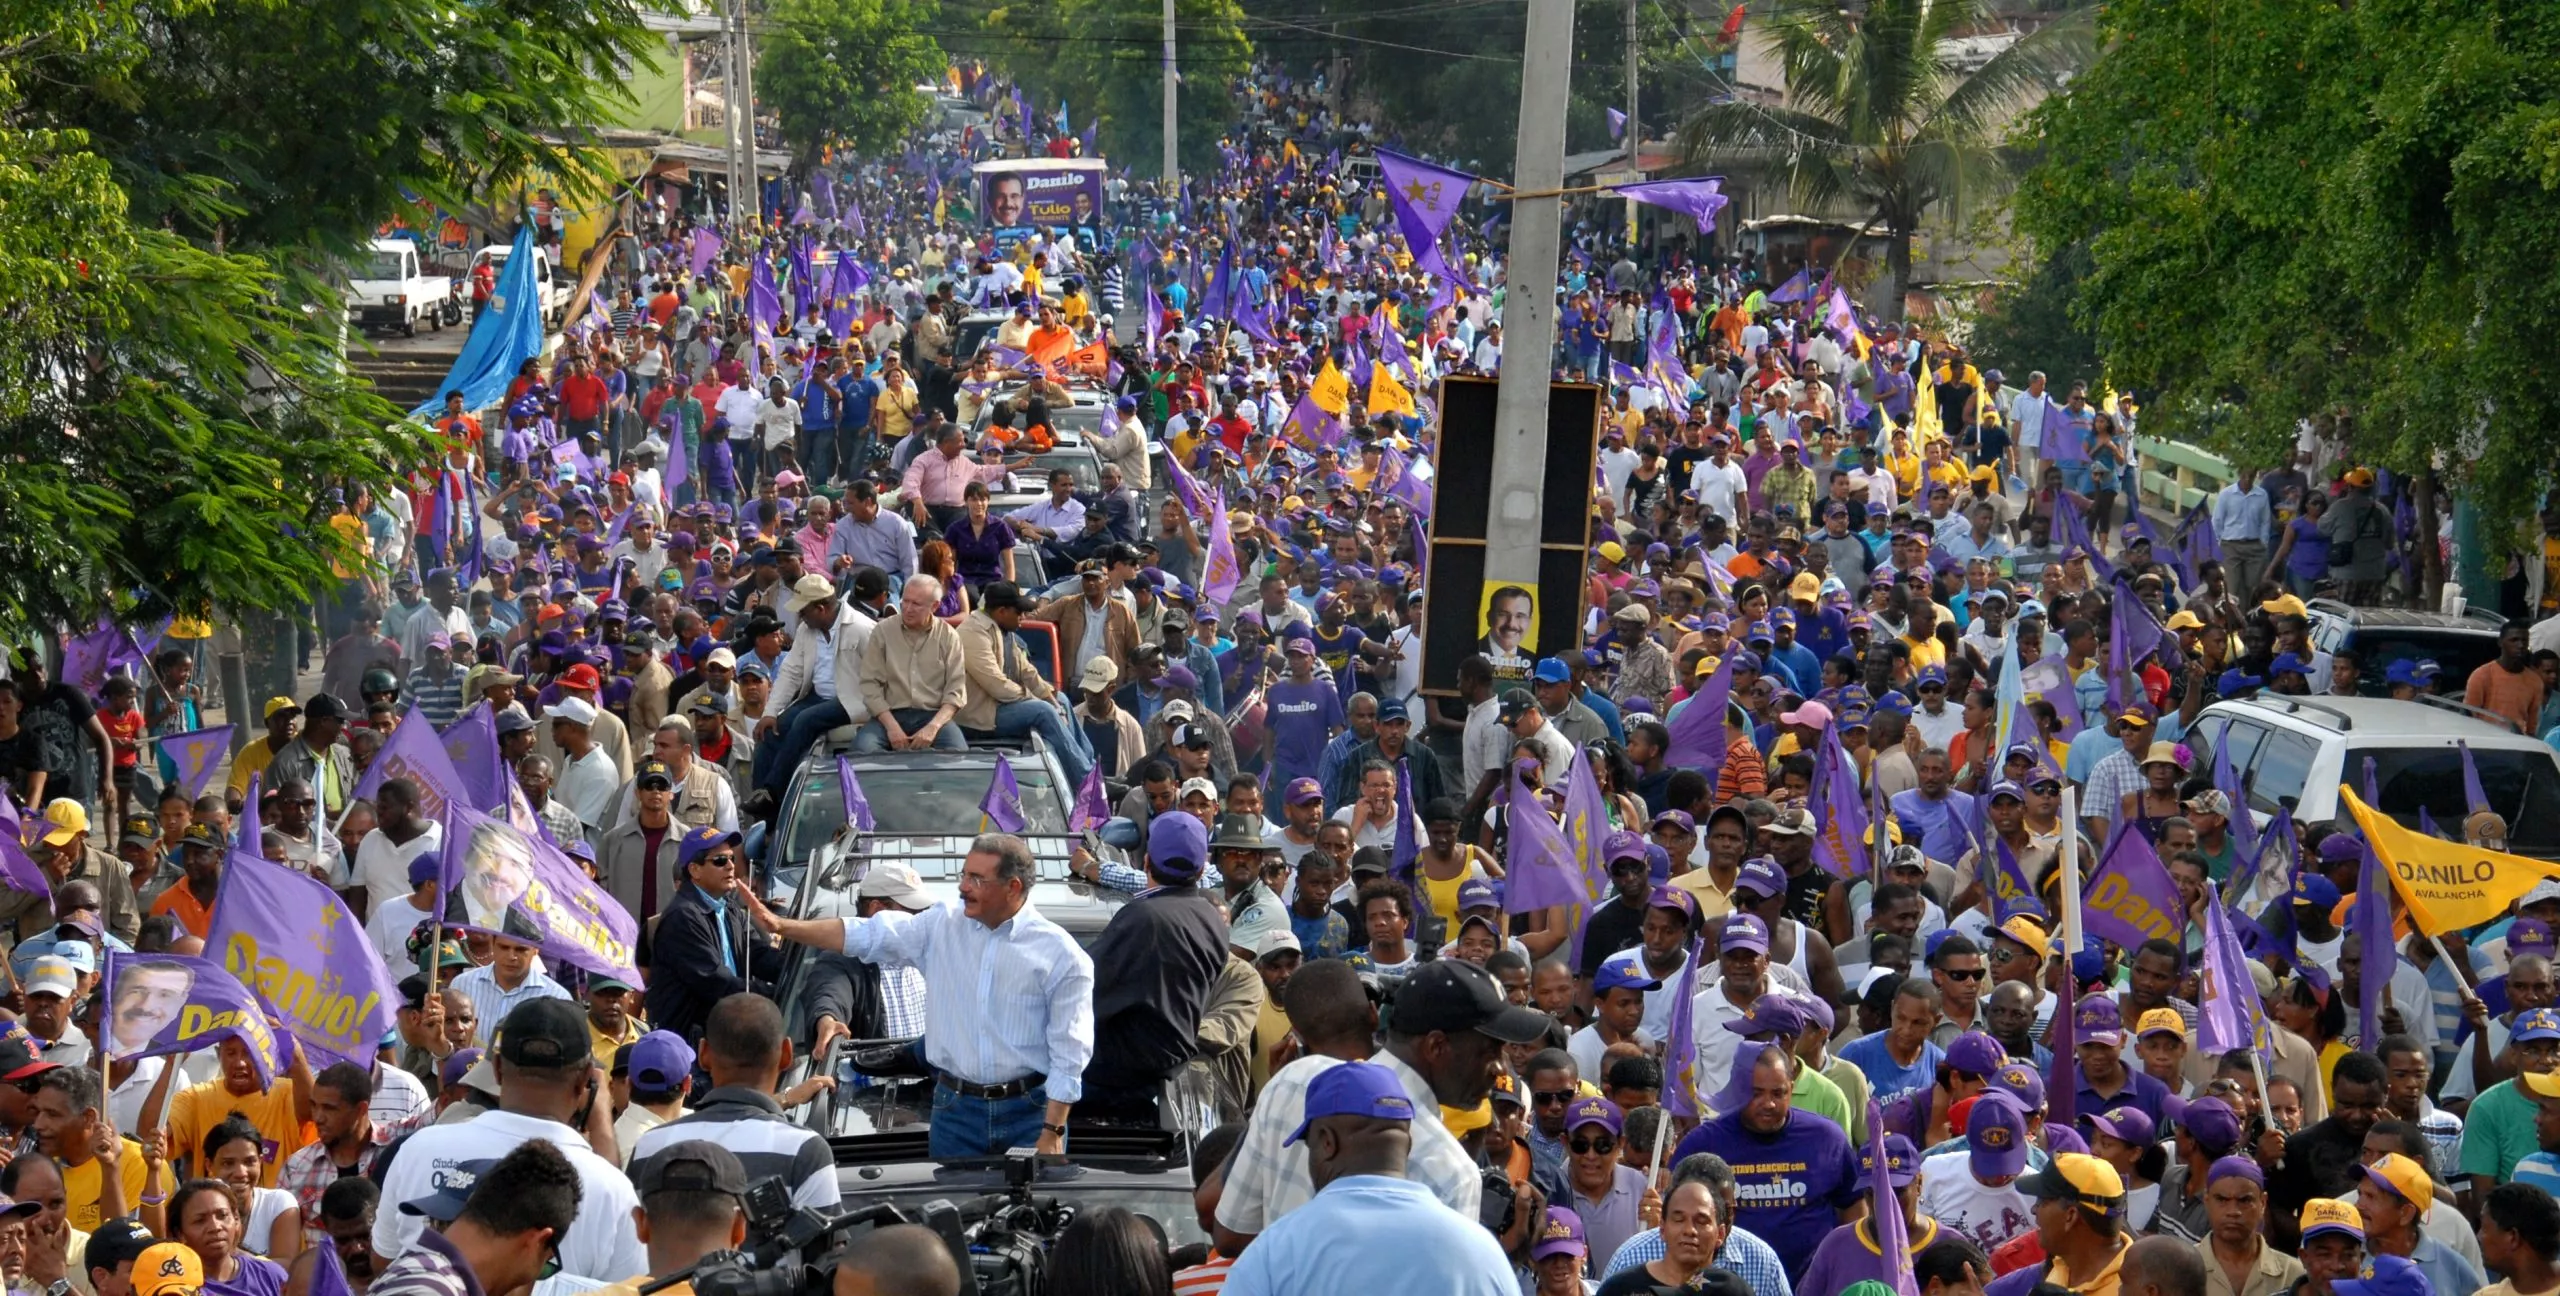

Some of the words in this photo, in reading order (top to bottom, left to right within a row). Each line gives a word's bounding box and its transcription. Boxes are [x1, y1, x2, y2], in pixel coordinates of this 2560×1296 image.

[1026, 172, 1086, 190] Danilo
[1277, 701, 1318, 713] Danilo
[2396, 861, 2495, 885] DANILO
[2415, 889, 2486, 900] AVALANCHA
[526, 880, 635, 969] Danilo!
[225, 932, 381, 1043] Danilo!
[2528, 1016, 2557, 1031] PLD
[1756, 1163, 1790, 1173] SANCHEZ
[1862, 1157, 1900, 1166] DALO
[1734, 1179, 1807, 1200] Danilo
[1735, 1198, 1807, 1208] ESIDENTE
[1545, 1225, 1571, 1234] ANILO
